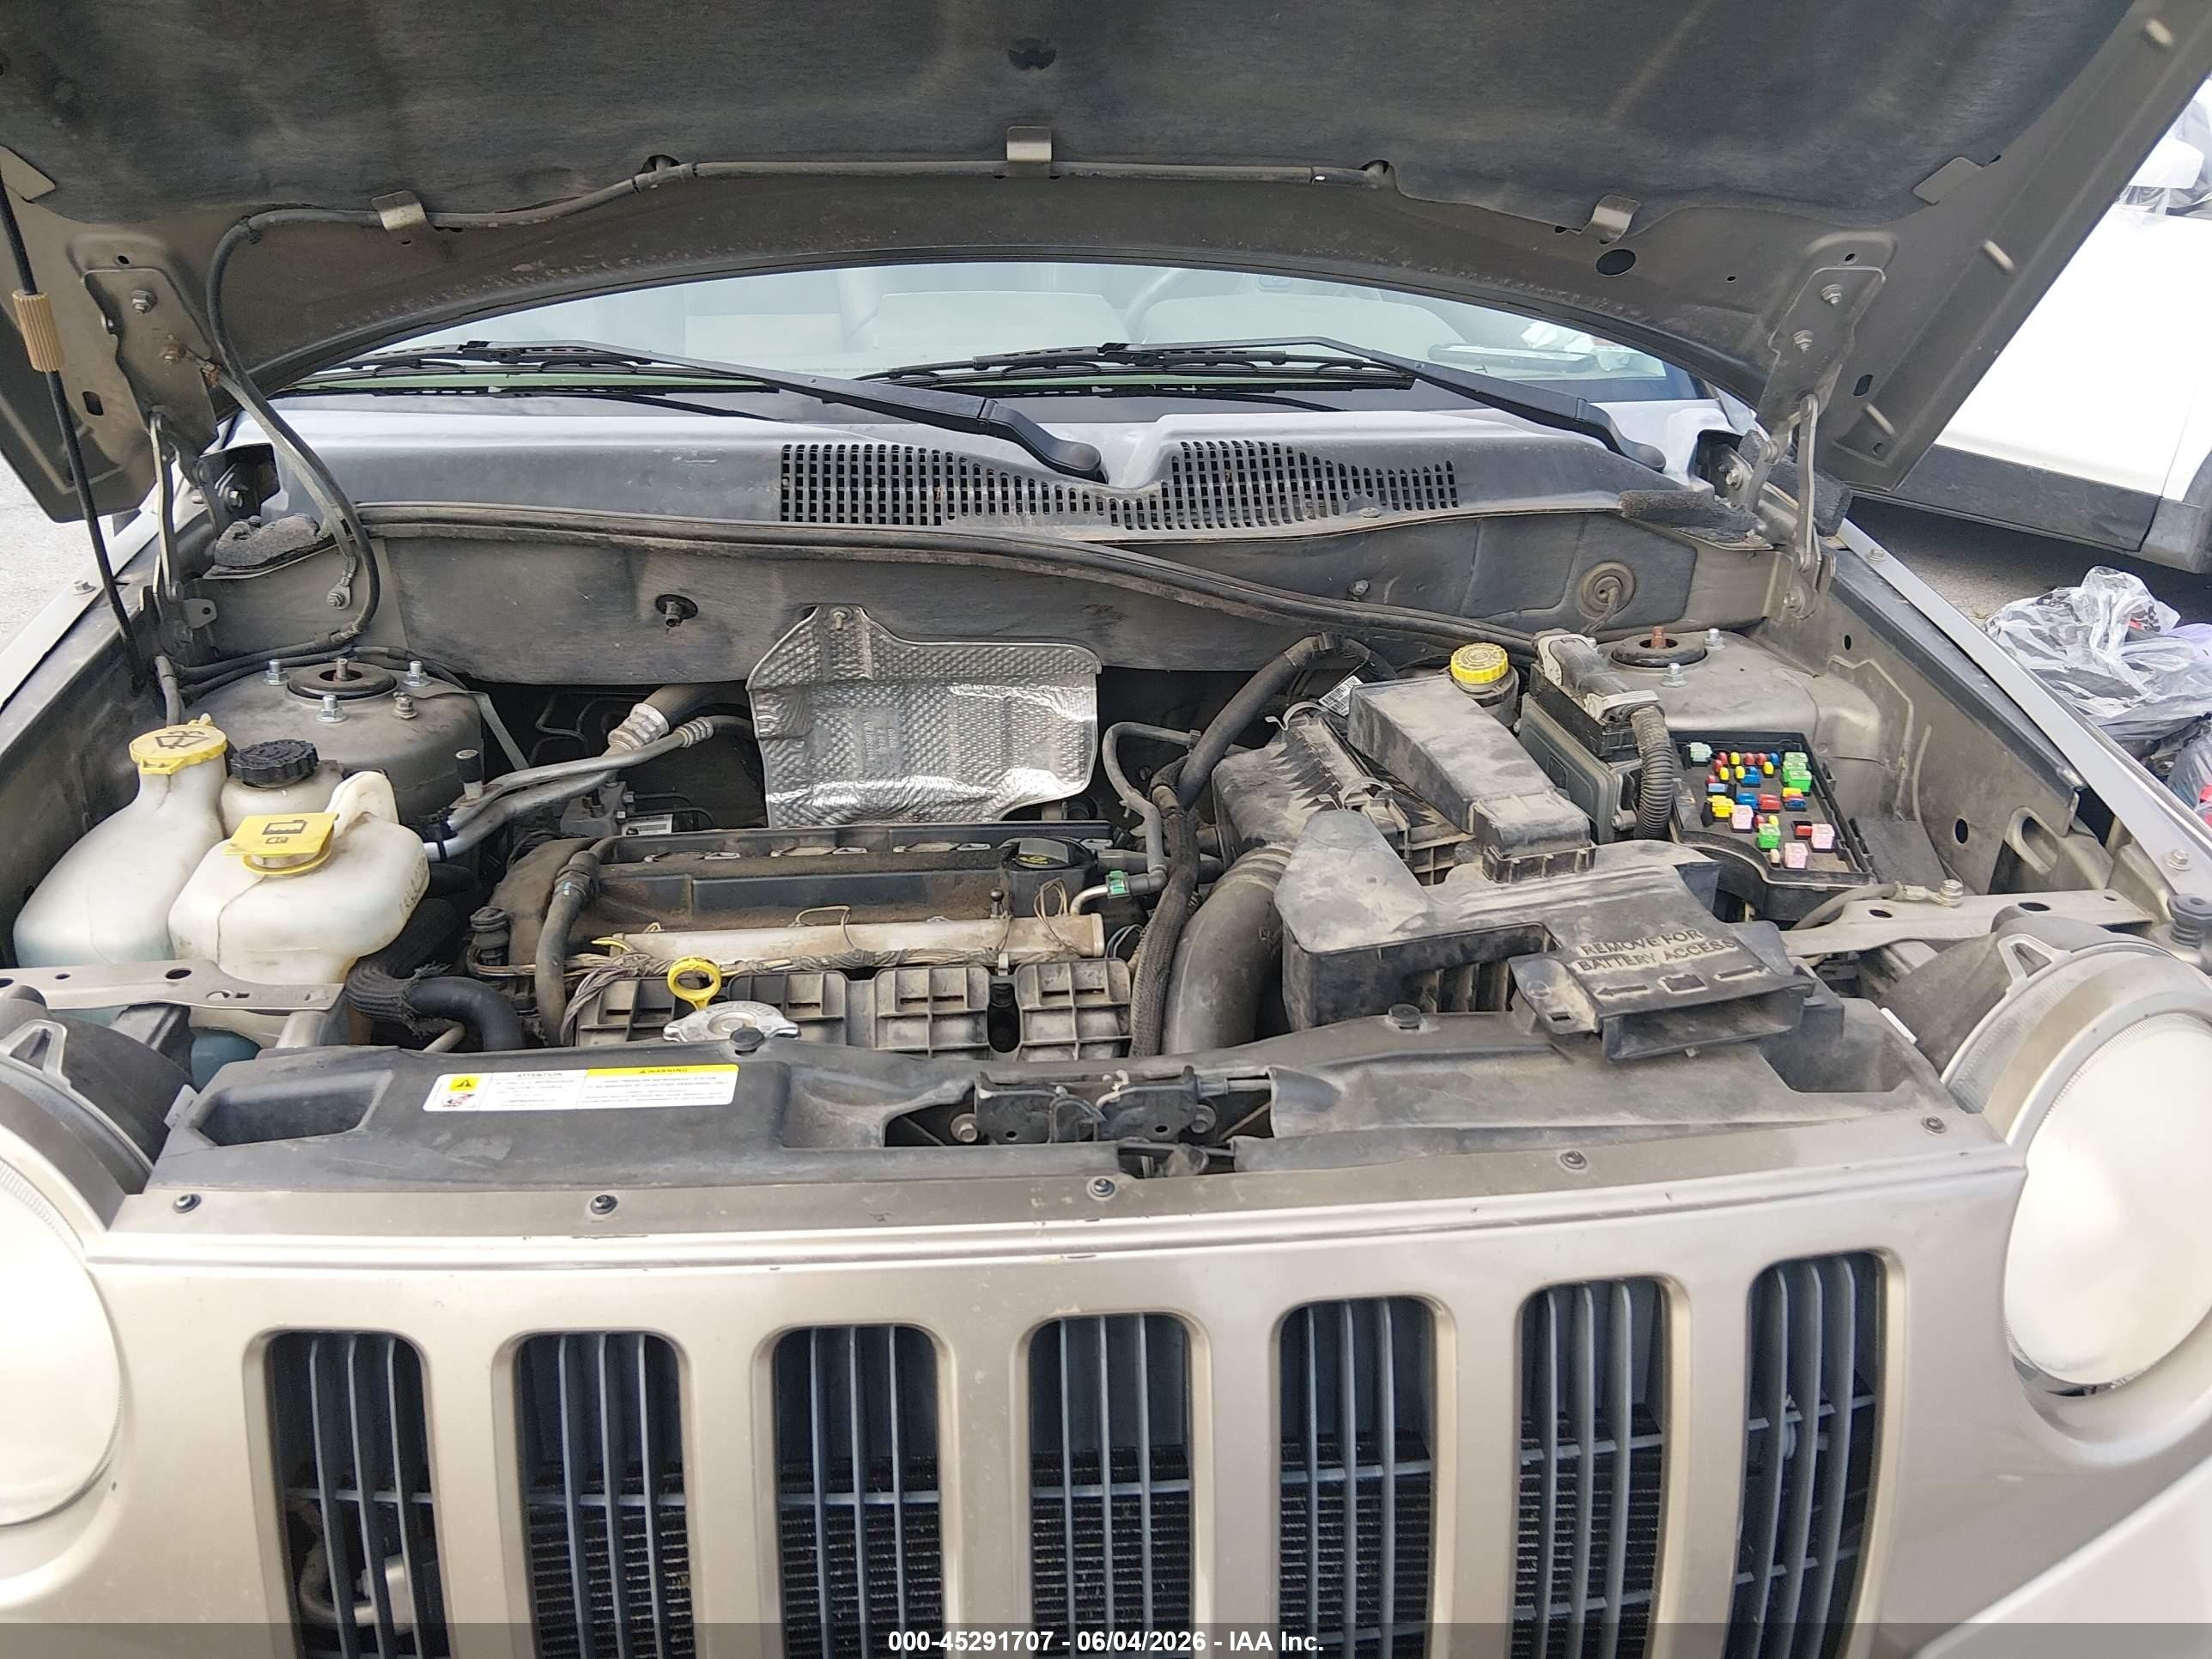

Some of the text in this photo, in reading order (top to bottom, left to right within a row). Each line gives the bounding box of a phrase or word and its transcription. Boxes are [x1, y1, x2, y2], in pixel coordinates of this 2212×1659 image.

[1577, 939, 1736, 972] BATTERY ACCESS
[1581, 928, 1704, 956] REMOVE FOR
